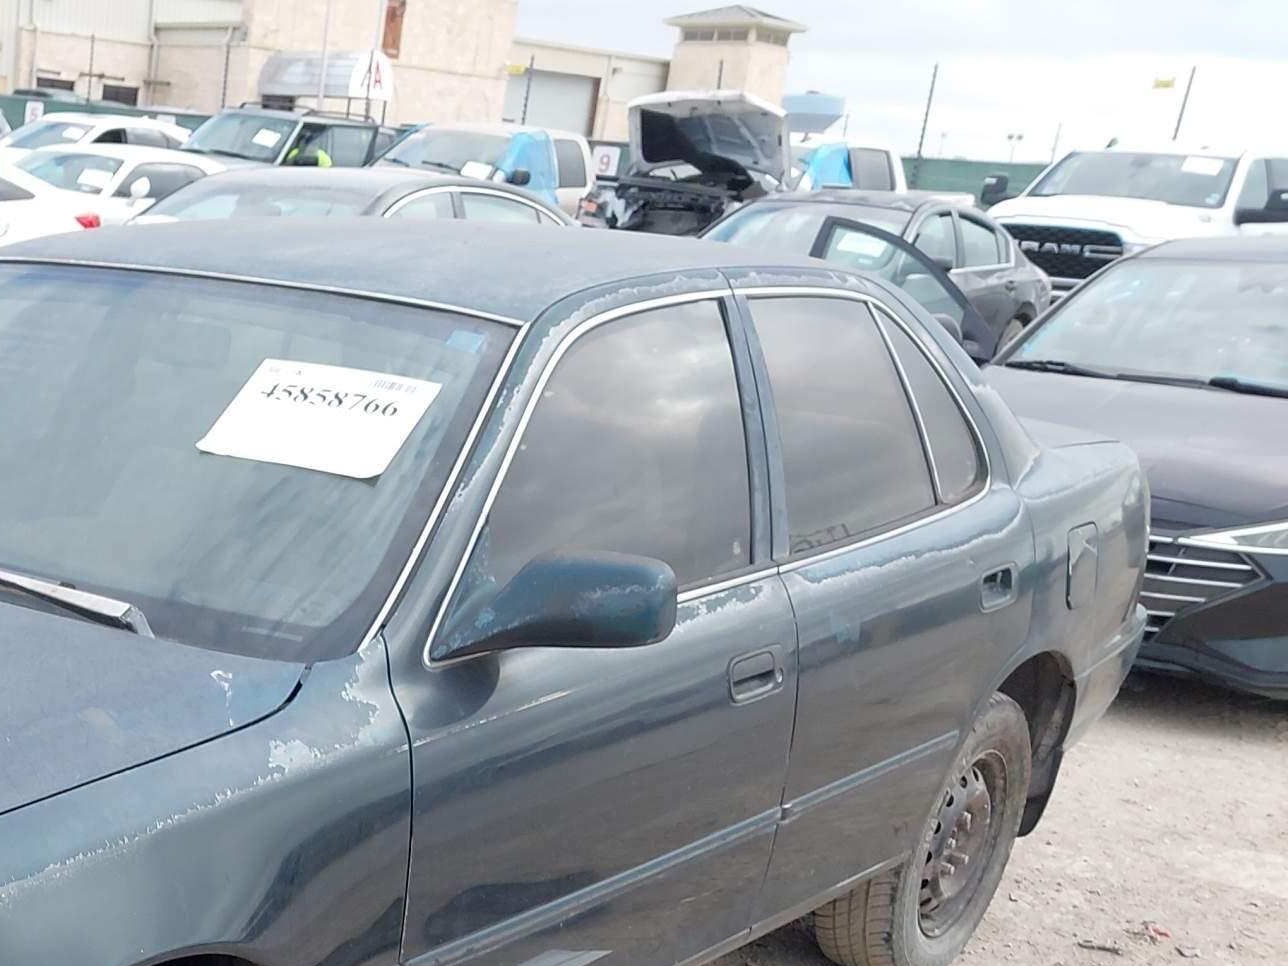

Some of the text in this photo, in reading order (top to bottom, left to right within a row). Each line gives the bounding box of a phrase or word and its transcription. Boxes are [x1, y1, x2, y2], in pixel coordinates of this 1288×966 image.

[598, 154, 611, 173] 9
[1021, 241, 1081, 255] RAM
[261, 383, 398, 416] 45858766
